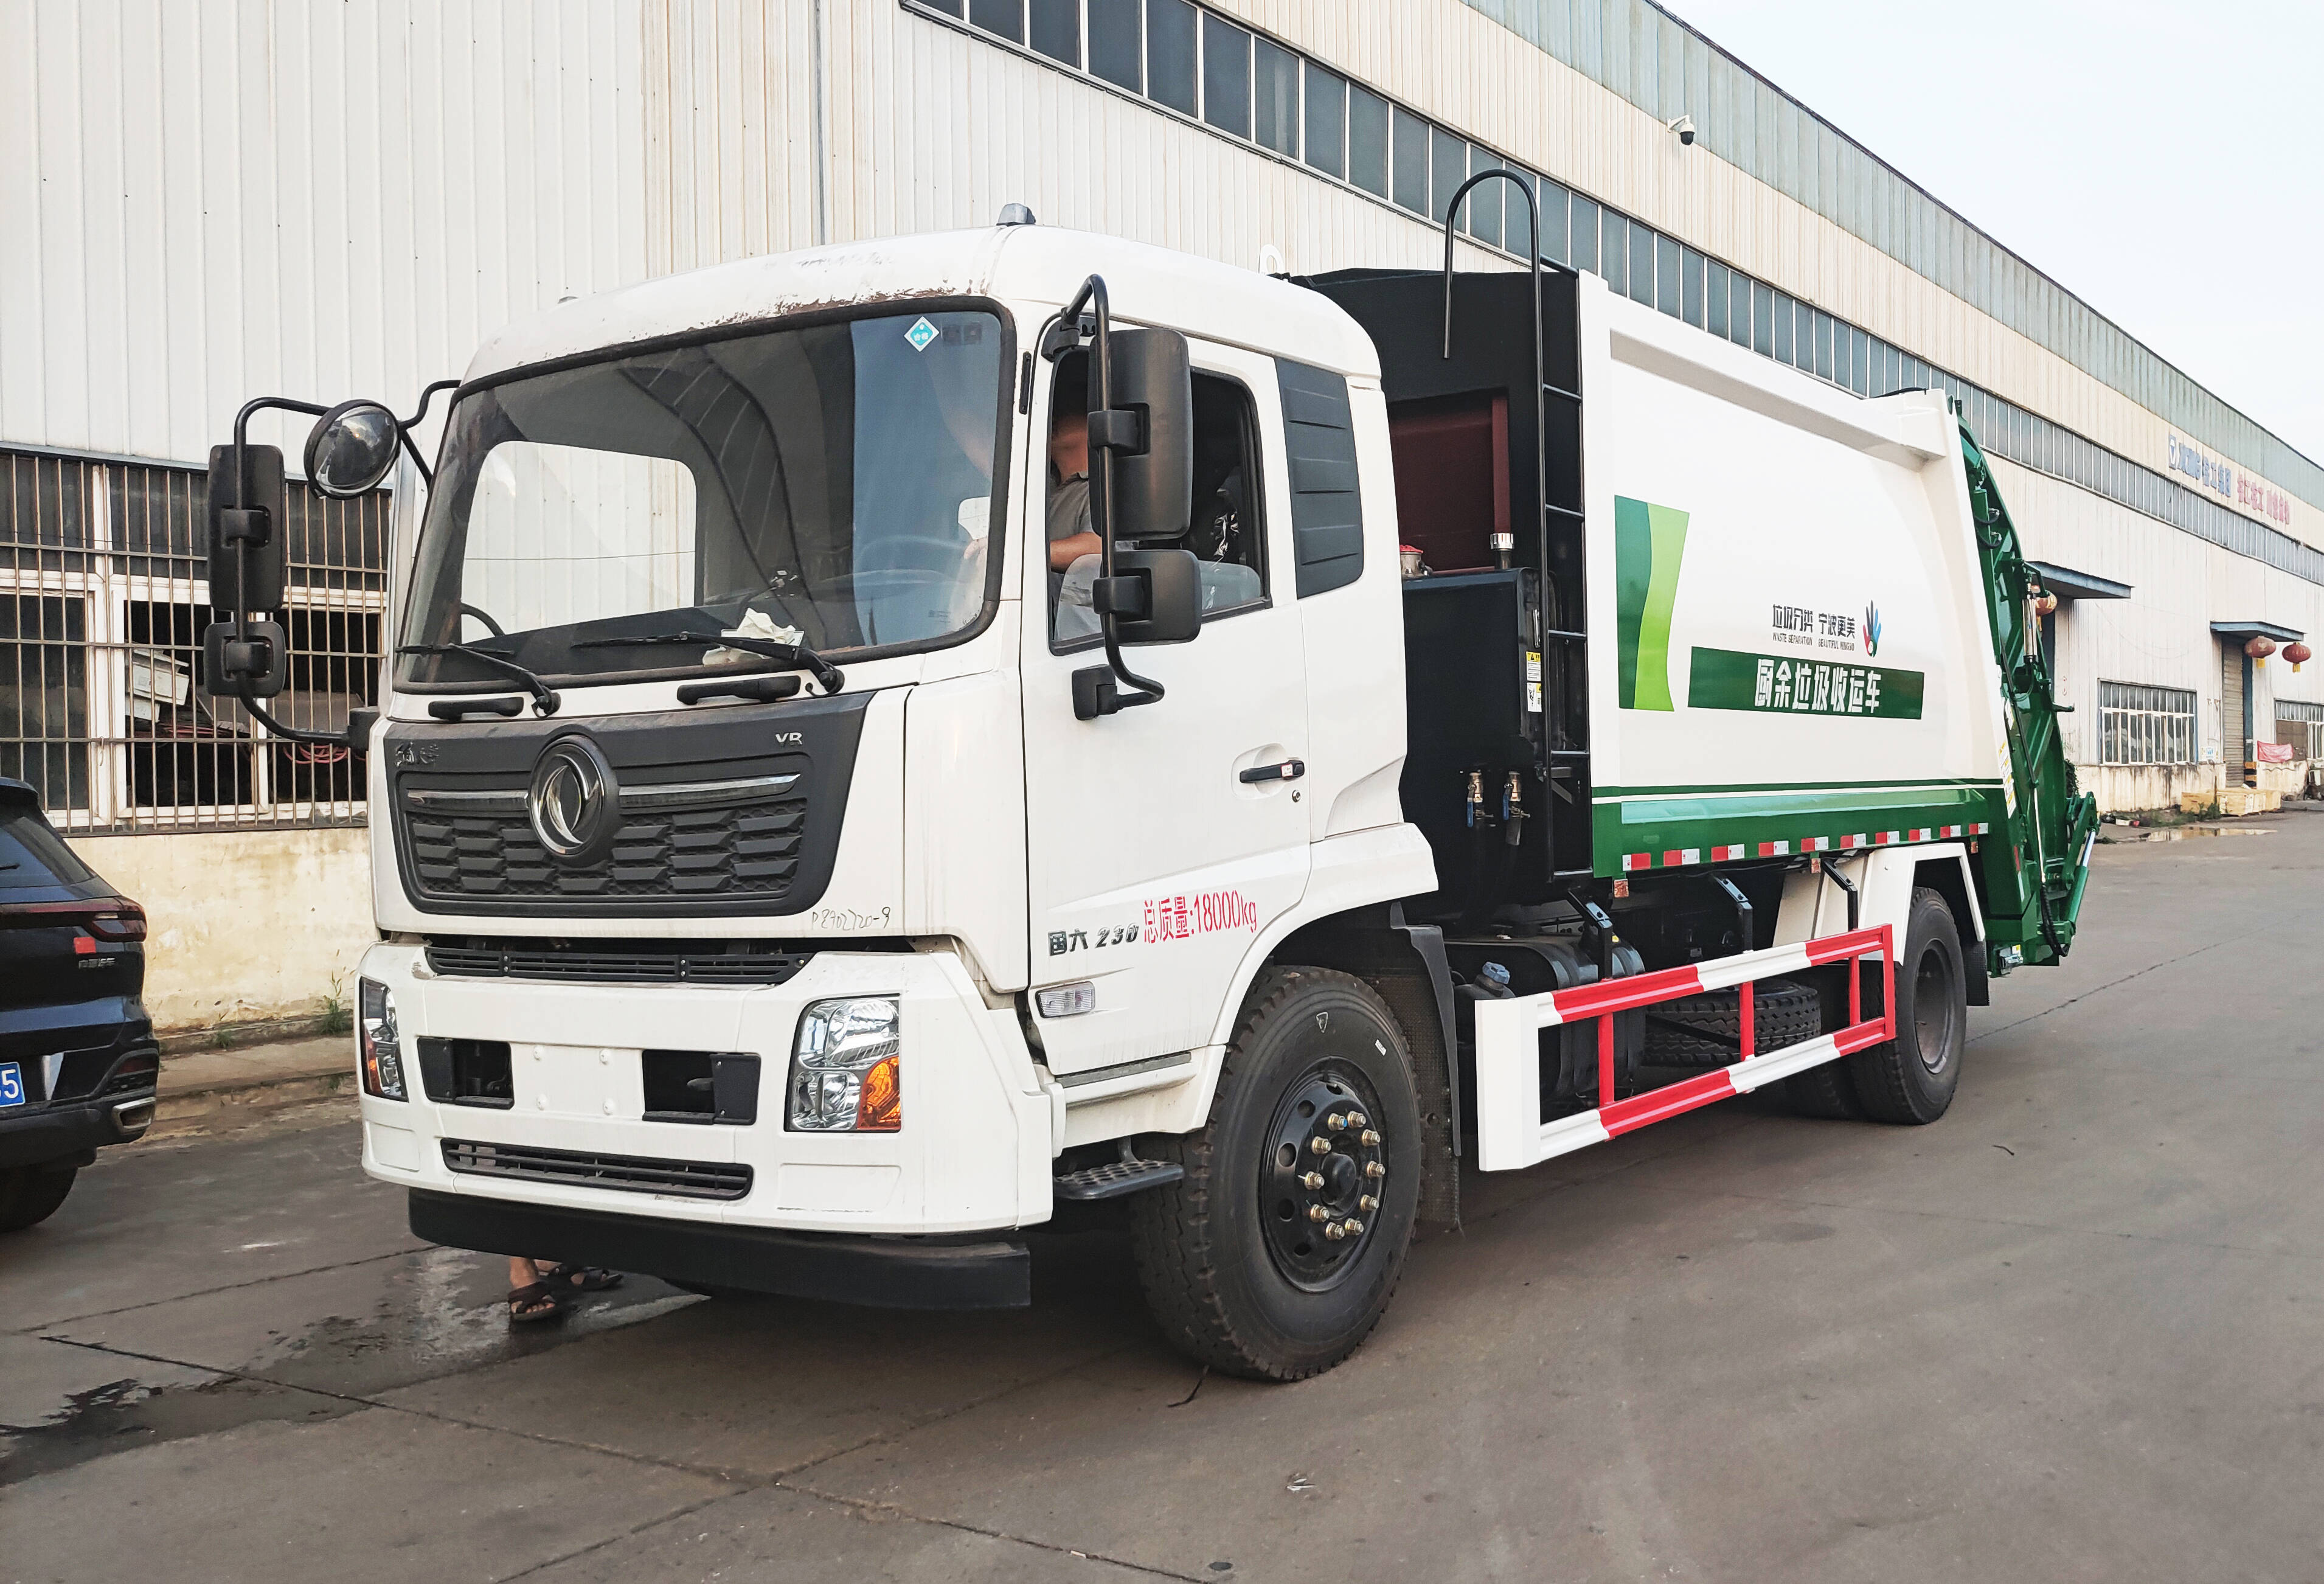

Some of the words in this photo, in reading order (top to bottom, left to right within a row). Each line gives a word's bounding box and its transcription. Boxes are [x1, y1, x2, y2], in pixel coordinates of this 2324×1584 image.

[1772, 604, 1813, 633] 垃圾分类
[1818, 613, 1855, 639] 宁波更美
[1772, 633, 1787, 643] WASTE
[1788, 634, 1813, 646] SEPARATION
[1818, 638, 1839, 649] BEAUTIFUL
[1754, 658, 1881, 714] 厨余垃圾收运车
[775, 731, 803, 746] VR
[1144, 890, 1257, 944] 总质量:18000kg
[1048, 928, 1089, 956] 国六
[1094, 922, 1139, 949] 230
[0, 1069, 19, 1099] 5
